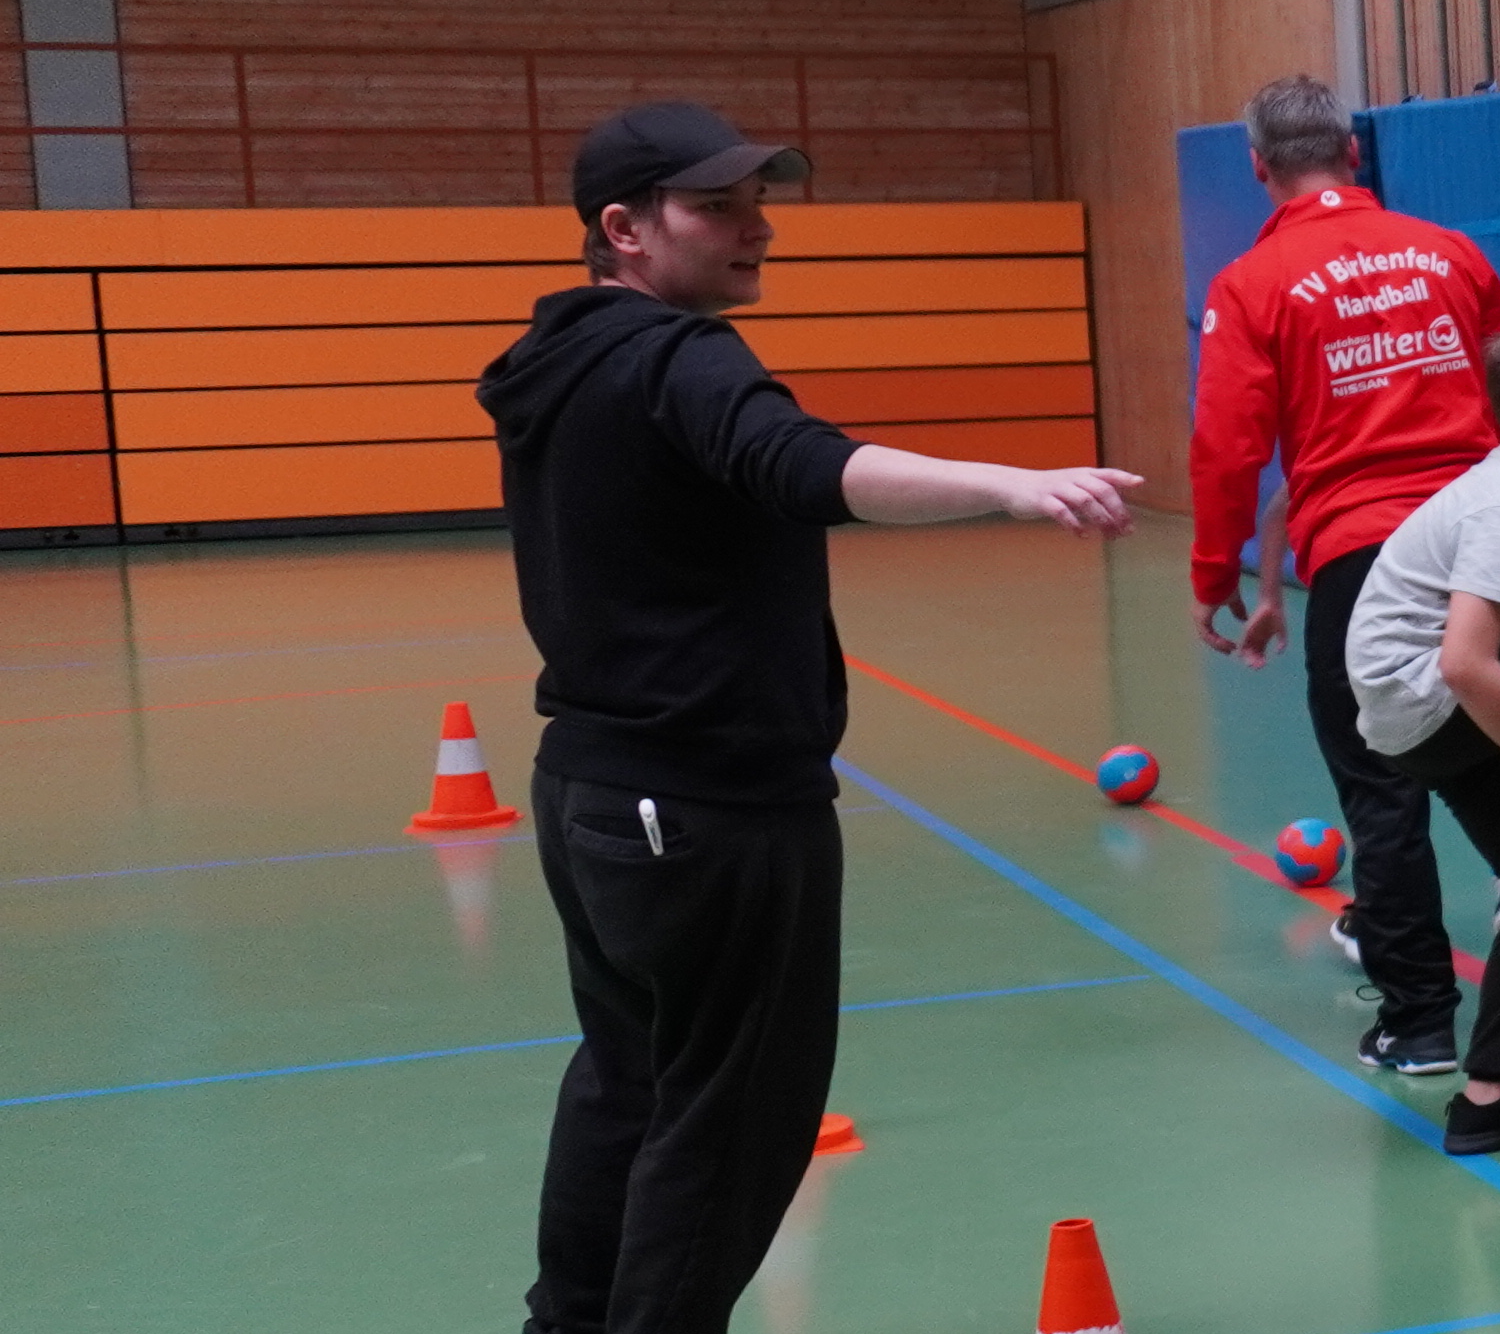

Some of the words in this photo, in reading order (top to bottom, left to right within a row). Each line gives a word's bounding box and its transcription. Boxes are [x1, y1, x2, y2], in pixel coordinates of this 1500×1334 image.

[1289, 271, 1327, 303] TV
[1325, 246, 1450, 283] Birkenfeld
[1334, 277, 1429, 319] Handball
[1323, 334, 1371, 352] autohaus
[1326, 331, 1425, 373] walter
[1332, 376, 1389, 397] NISSAN
